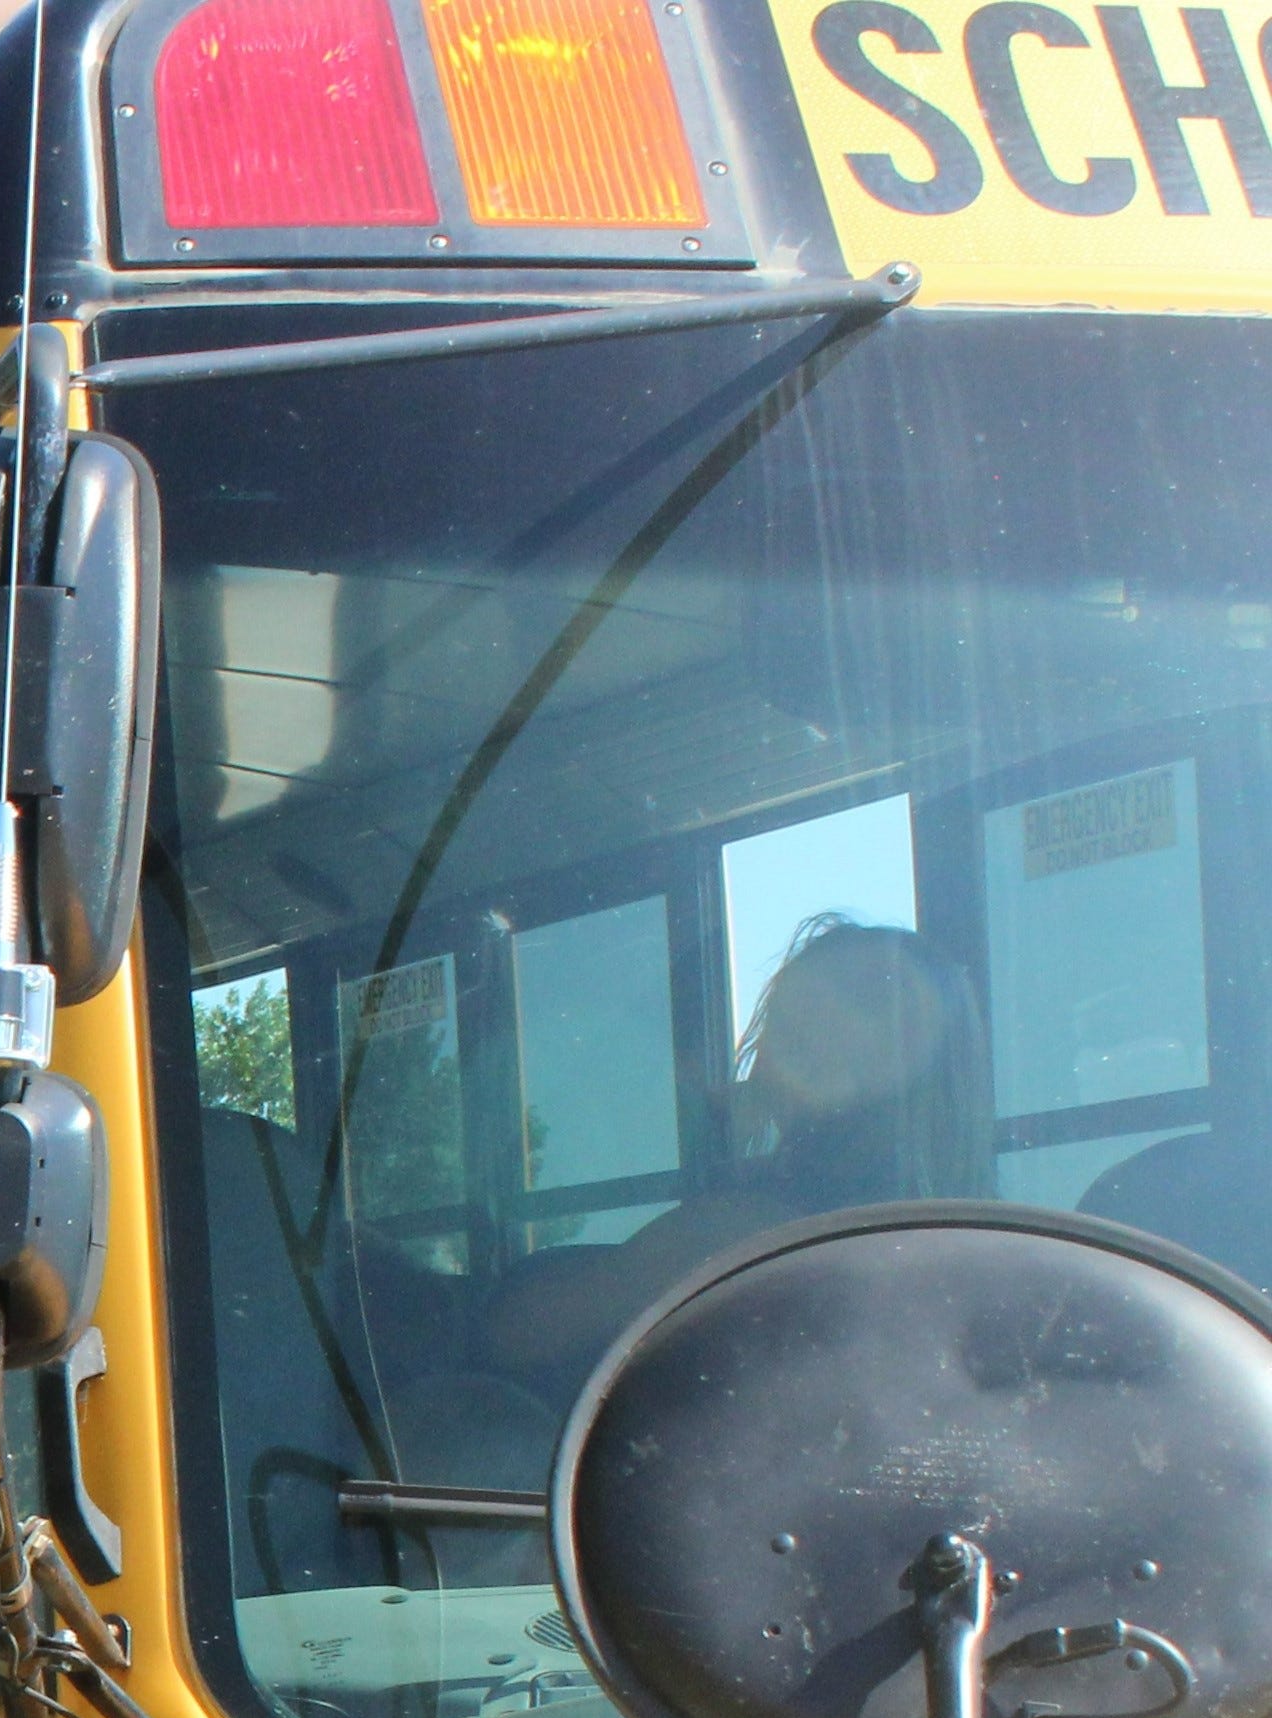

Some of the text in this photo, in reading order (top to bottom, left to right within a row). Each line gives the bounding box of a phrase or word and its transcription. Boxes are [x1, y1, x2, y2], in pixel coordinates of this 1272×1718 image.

[811, 1, 1272, 218] SCH
[1026, 771, 1173, 850] EMERGENCY EXIT
[1070, 840, 1099, 867] NOT
[1103, 827, 1151, 860] BLOCK
